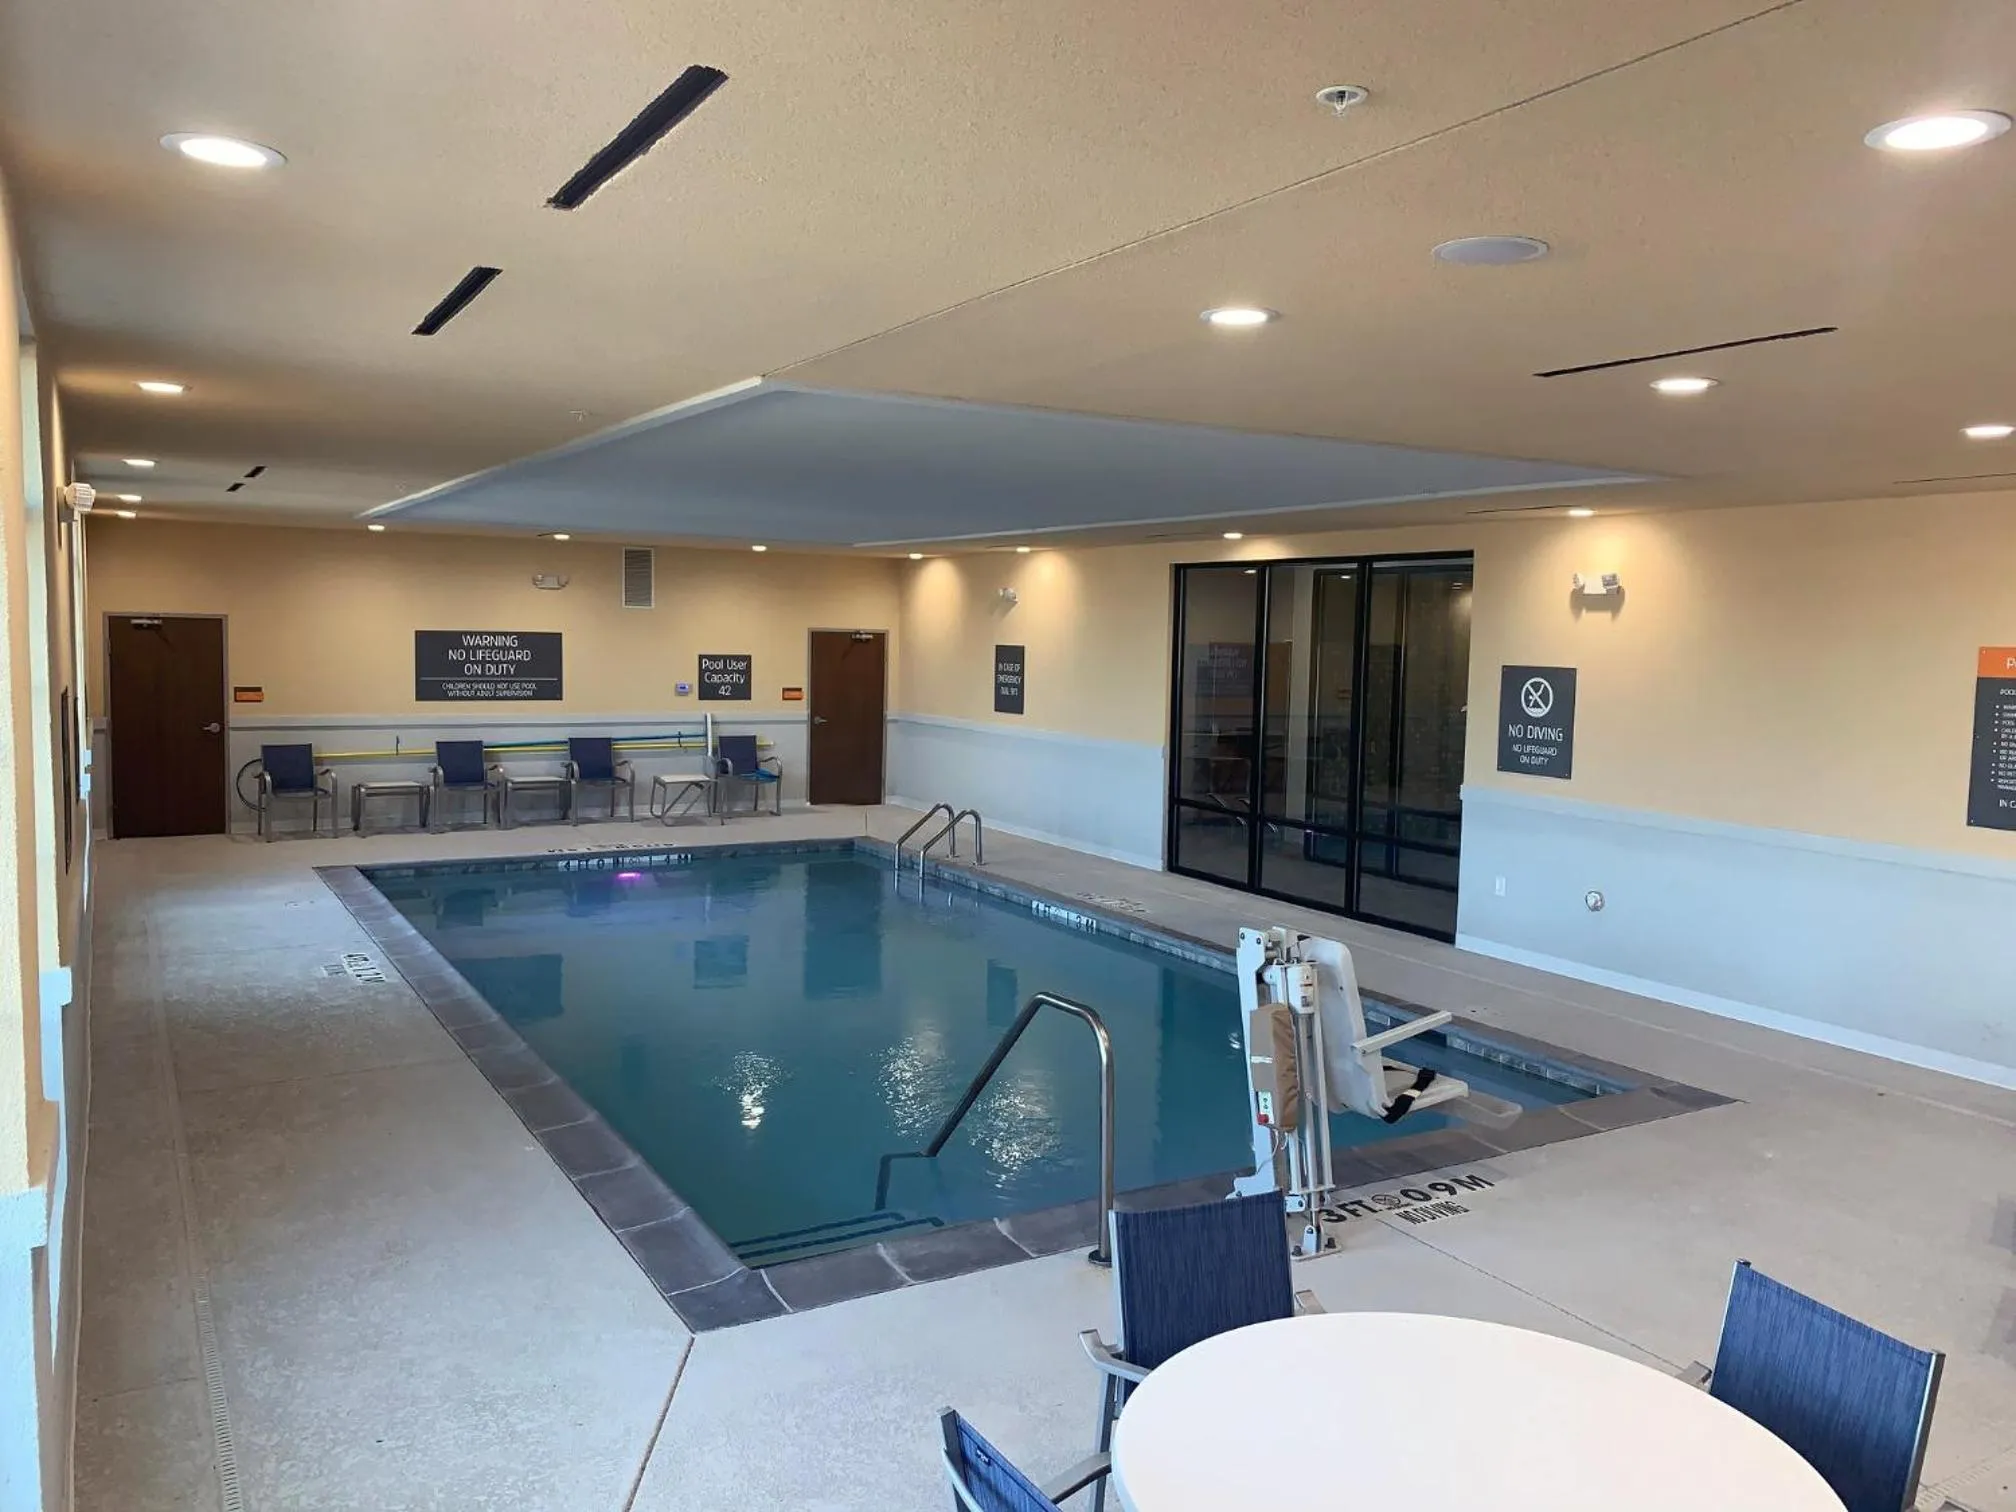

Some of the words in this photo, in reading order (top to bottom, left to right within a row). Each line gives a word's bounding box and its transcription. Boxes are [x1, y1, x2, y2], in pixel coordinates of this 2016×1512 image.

[462, 634, 518, 647] WARNING
[448, 649, 466, 661] NO
[469, 649, 531, 661] LIFEGUARD
[464, 663, 482, 675] ON
[485, 663, 517, 675] DUTY
[702, 658, 724, 670] Pool
[726, 658, 747, 670] User
[704, 672, 745, 684] Capacity
[718, 685, 732, 696] 42
[1508, 724, 1524, 738] NO
[1527, 725, 1563, 741] DIVING
[1512, 744, 1522, 752] NO
[1523, 744, 1557, 756] LIFEGUARD
[1519, 755, 1530, 764] ON
[1530, 756, 1550, 765] DUTY
[1394, 1210, 1428, 1225] NO
[1411, 1201, 1471, 1221] DIVING
